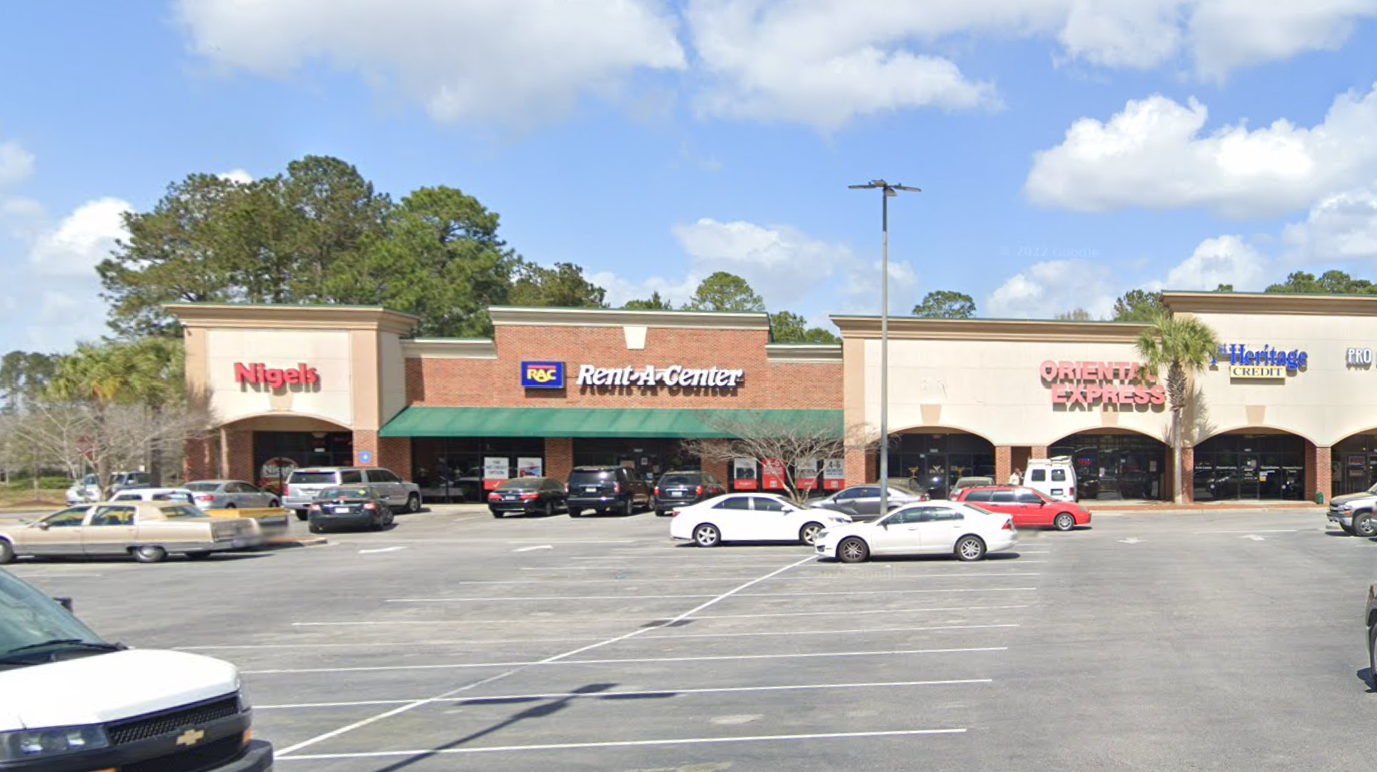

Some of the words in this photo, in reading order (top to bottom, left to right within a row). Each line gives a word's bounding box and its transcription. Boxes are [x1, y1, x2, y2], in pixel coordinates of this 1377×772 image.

[1230, 344, 1308, 370] Heritage
[1347, 348, 1371, 363] PRO
[234, 362, 317, 389] Nigels
[527, 368, 556, 383] RAC
[576, 364, 743, 386] Rent-A-Center
[1040, 360, 1157, 382] ORIENTAL
[1233, 367, 1283, 376] CREDIT
[1051, 384, 1166, 405] EXPRESS
